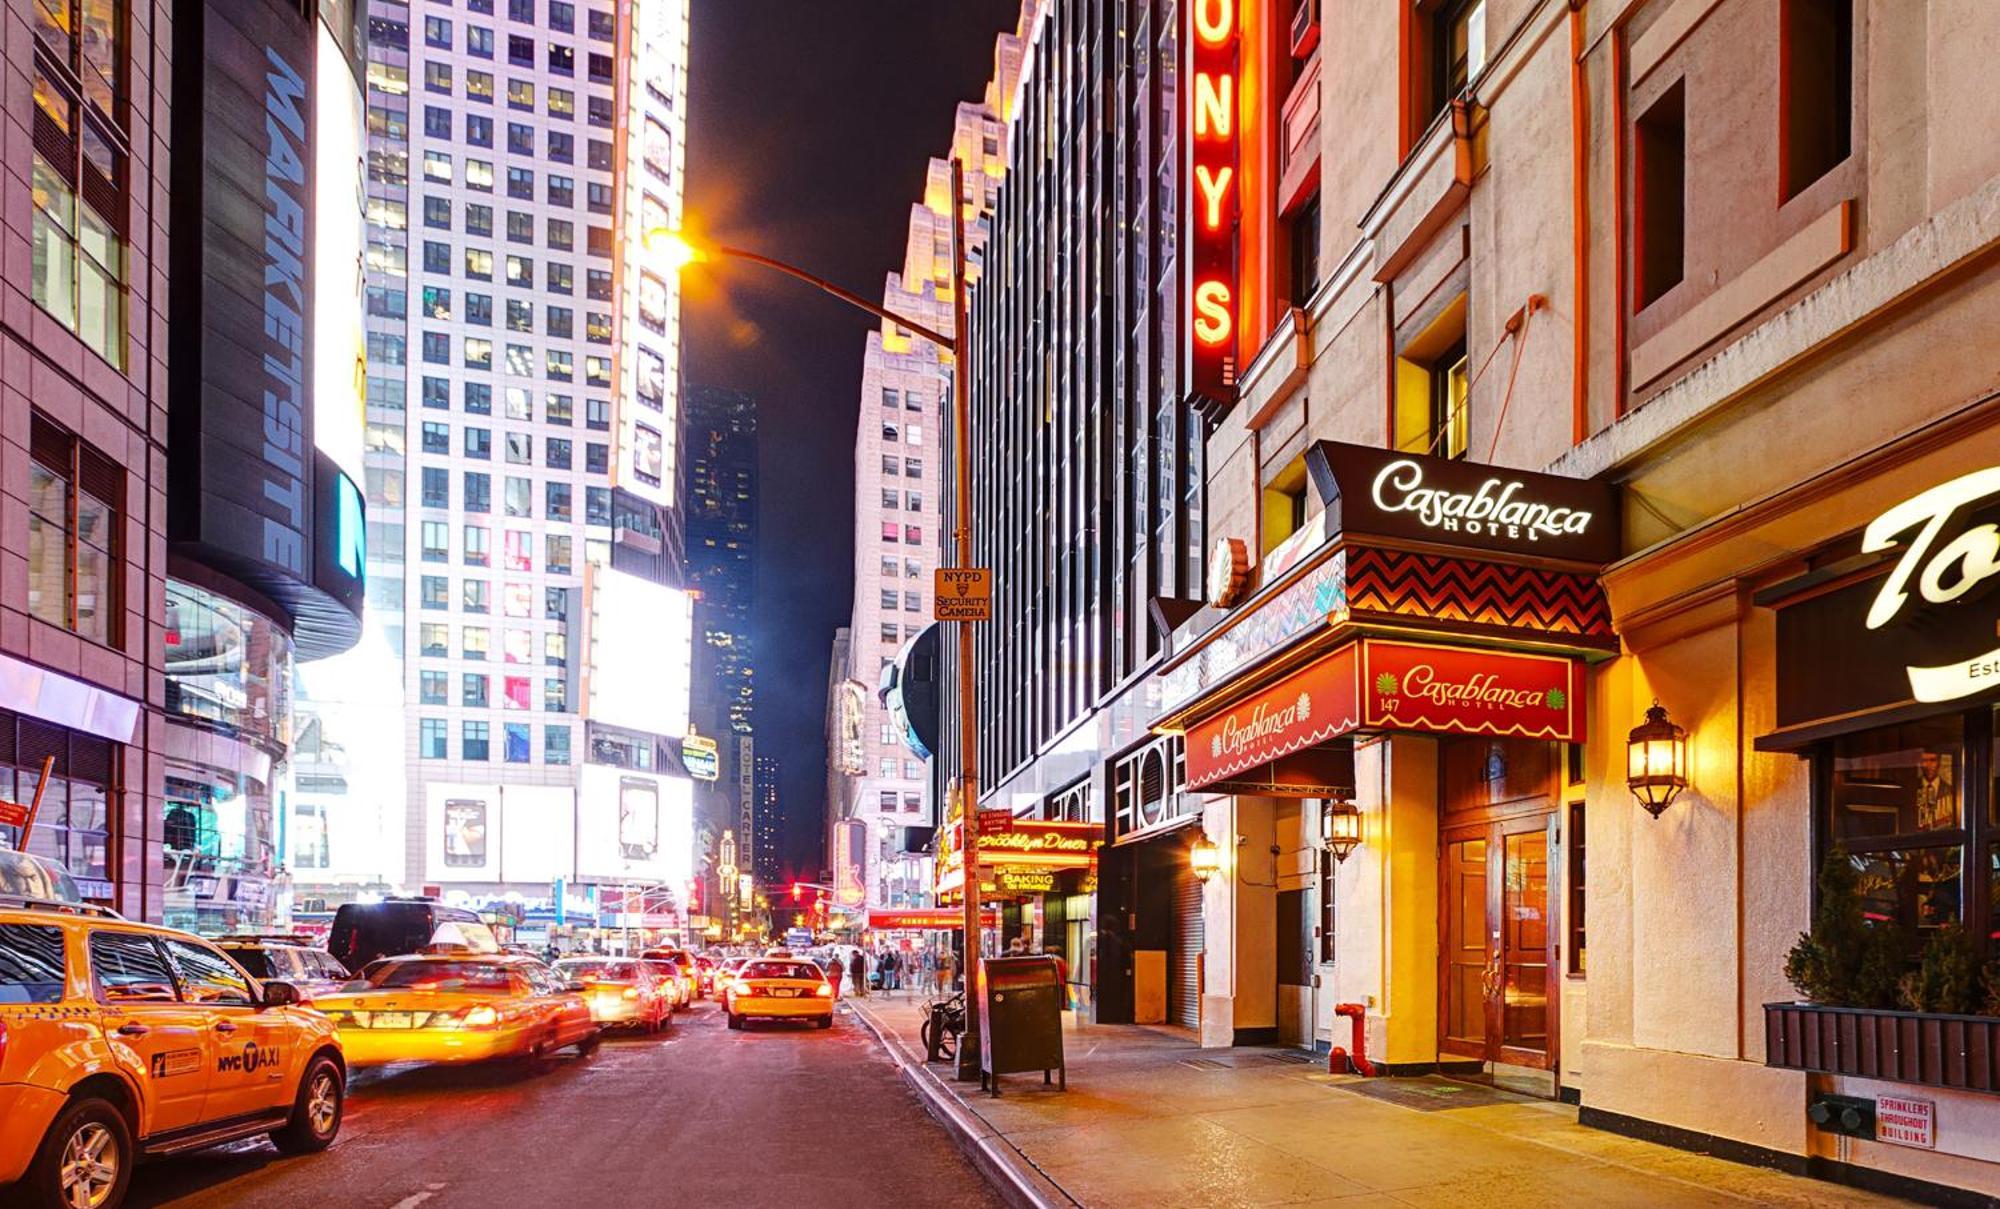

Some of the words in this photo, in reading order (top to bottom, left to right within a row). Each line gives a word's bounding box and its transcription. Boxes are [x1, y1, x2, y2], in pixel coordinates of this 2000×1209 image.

[1194, 0, 1233, 344] ONYS
[264, 44, 305, 578] MARKETSITE
[1371, 459, 1593, 537] Casablanca
[1442, 516, 1539, 542] HOTEL
[944, 572, 982, 582] NYPD
[1402, 664, 1544, 709] Casablanca
[1380, 698, 1400, 713] 147
[1448, 699, 1505, 711] HOTEL
[1222, 701, 1296, 756] Casablanca
[742, 800, 752, 863] CARTER
[1044, 832, 1088, 850] Diner
[1003, 874, 1055, 885] BAKING
[217, 1055, 242, 1073] NYC
[243, 1041, 280, 1073] TAXI
[1880, 1098, 1929, 1116] SPRINKLERS
[1880, 1112, 1928, 1130] THROUGHOUT
[1881, 1125, 1927, 1144] BUILDING
